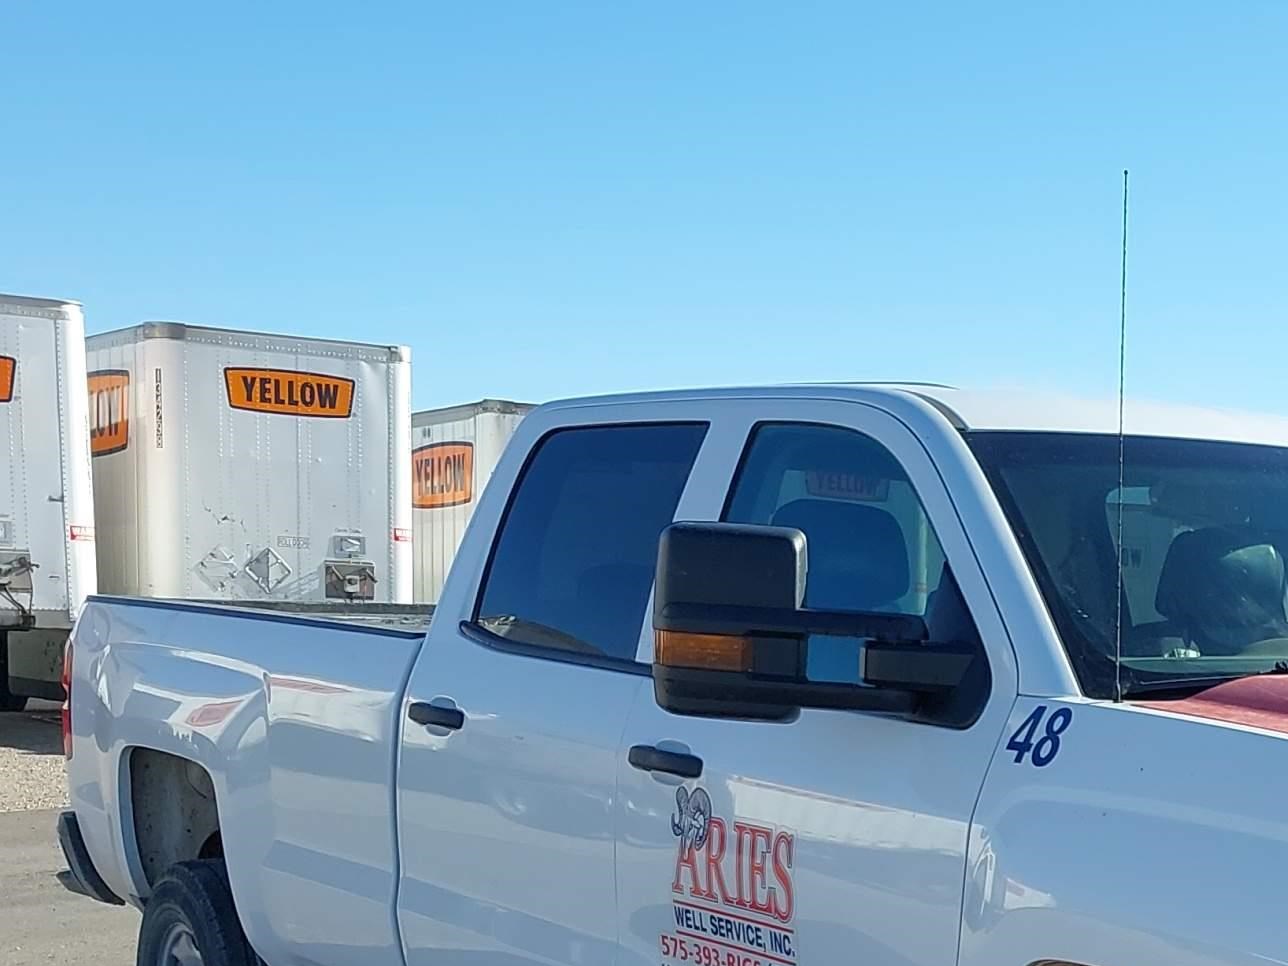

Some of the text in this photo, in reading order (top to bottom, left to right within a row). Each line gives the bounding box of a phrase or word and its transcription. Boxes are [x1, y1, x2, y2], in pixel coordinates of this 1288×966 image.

[89, 385, 121, 438] LOW
[241, 375, 339, 409] YELLOW
[415, 453, 465, 497] YELLOW
[1006, 705, 1073, 767] 48
[671, 816, 796, 924] ARIES
[673, 905, 796, 957] WELL SERVICE, INC.
